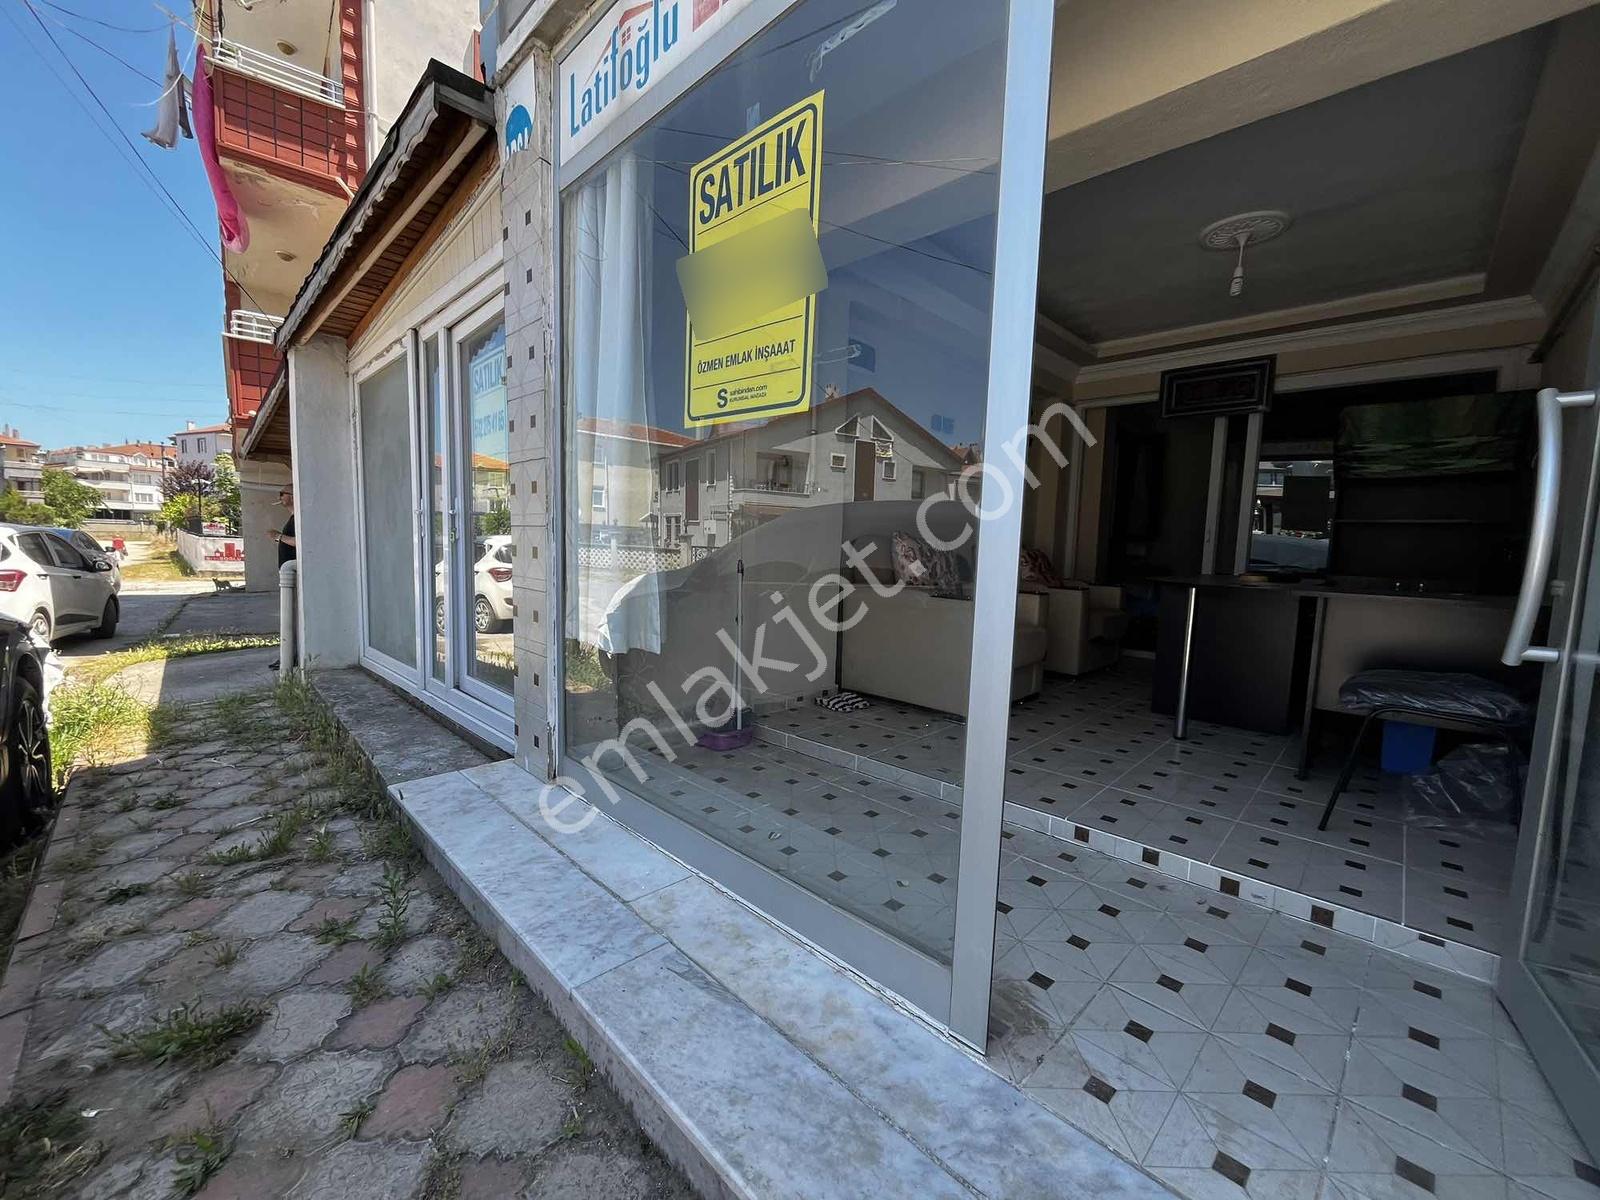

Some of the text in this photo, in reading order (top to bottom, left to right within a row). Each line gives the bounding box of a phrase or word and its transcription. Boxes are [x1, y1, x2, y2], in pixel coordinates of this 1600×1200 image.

[570, 0, 679, 138] Latifoğlu
[699, 118, 806, 225] SATILIK
[697, 356, 724, 375] ÖZMEN
[725, 350, 753, 367] EMLAK
